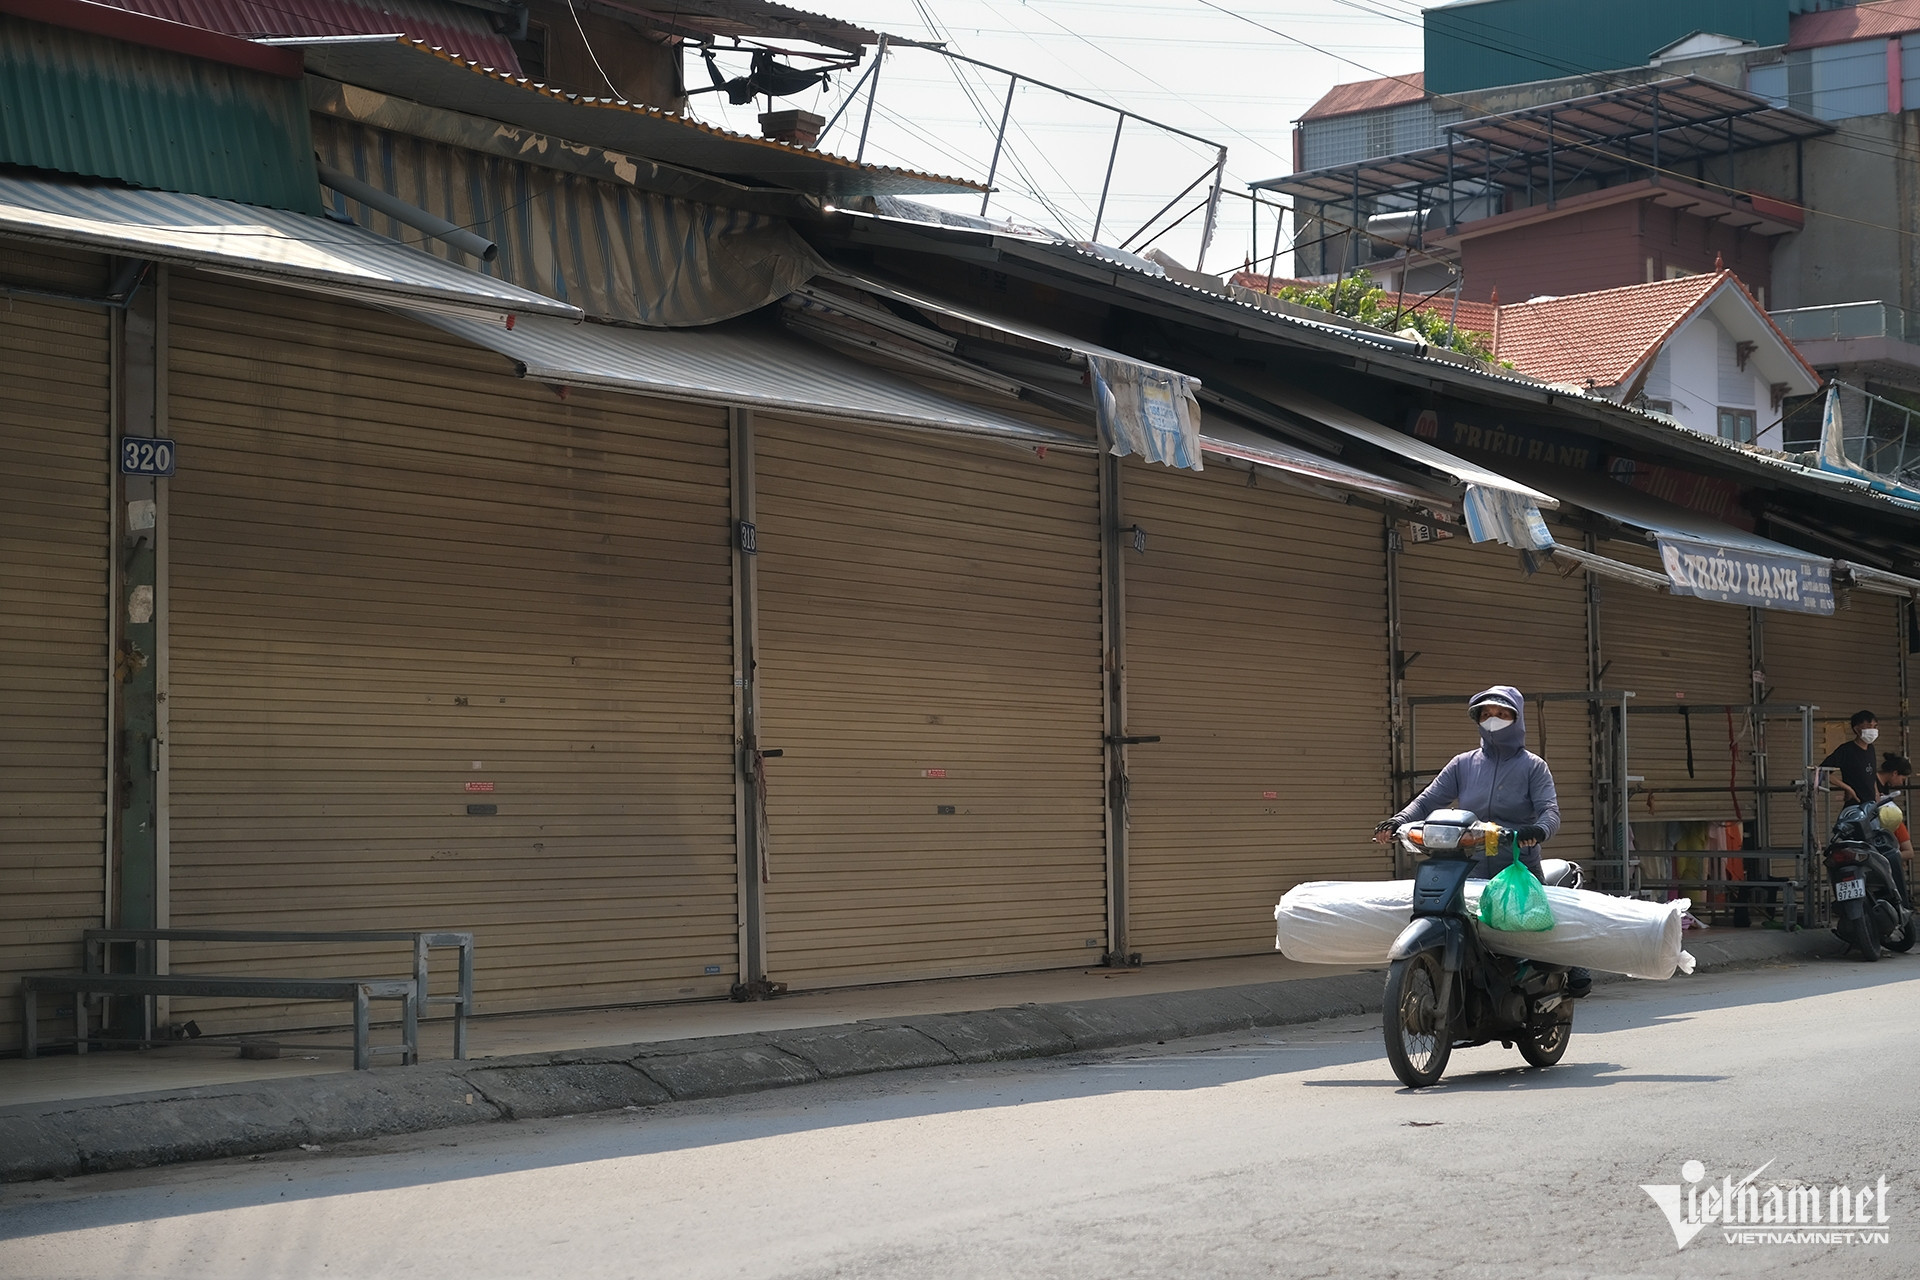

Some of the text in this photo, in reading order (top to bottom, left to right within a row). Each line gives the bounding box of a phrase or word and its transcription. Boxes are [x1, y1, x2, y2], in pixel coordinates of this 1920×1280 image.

[125, 442, 170, 471] 320
[742, 526, 755, 549] 318
[1134, 529, 1145, 552] 316
[1684, 547, 1800, 606] TRIỆU HẠNH
[1838, 888, 1863, 901] 972.32
